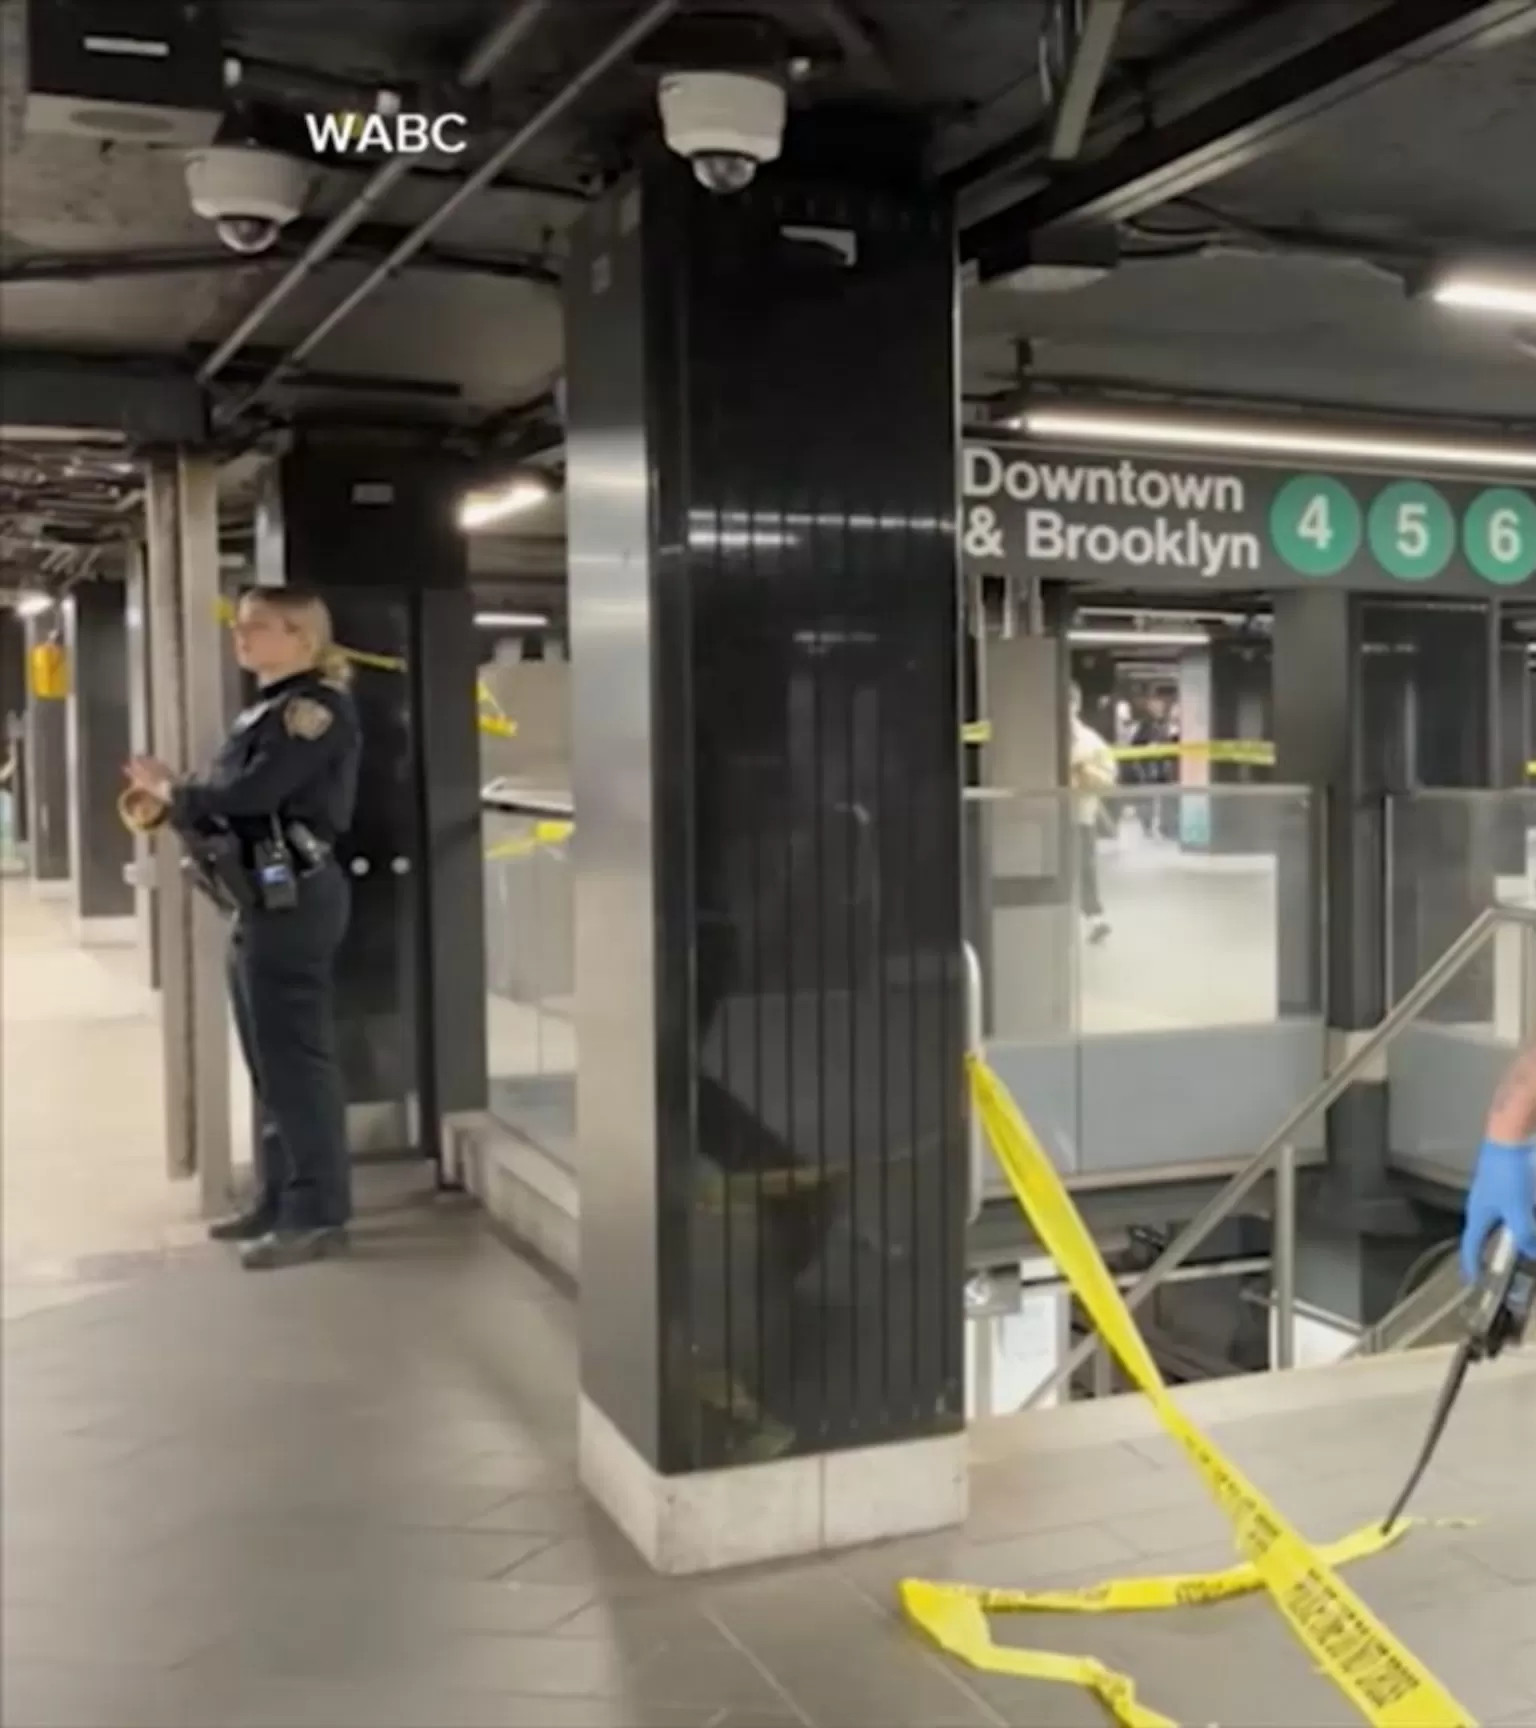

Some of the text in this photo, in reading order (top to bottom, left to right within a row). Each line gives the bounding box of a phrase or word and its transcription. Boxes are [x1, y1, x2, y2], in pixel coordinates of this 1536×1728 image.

[961, 447, 1245, 513] Downtown
[962, 504, 1261, 578] & Brooklyn
[1296, 494, 1522, 564] 4 5 6
